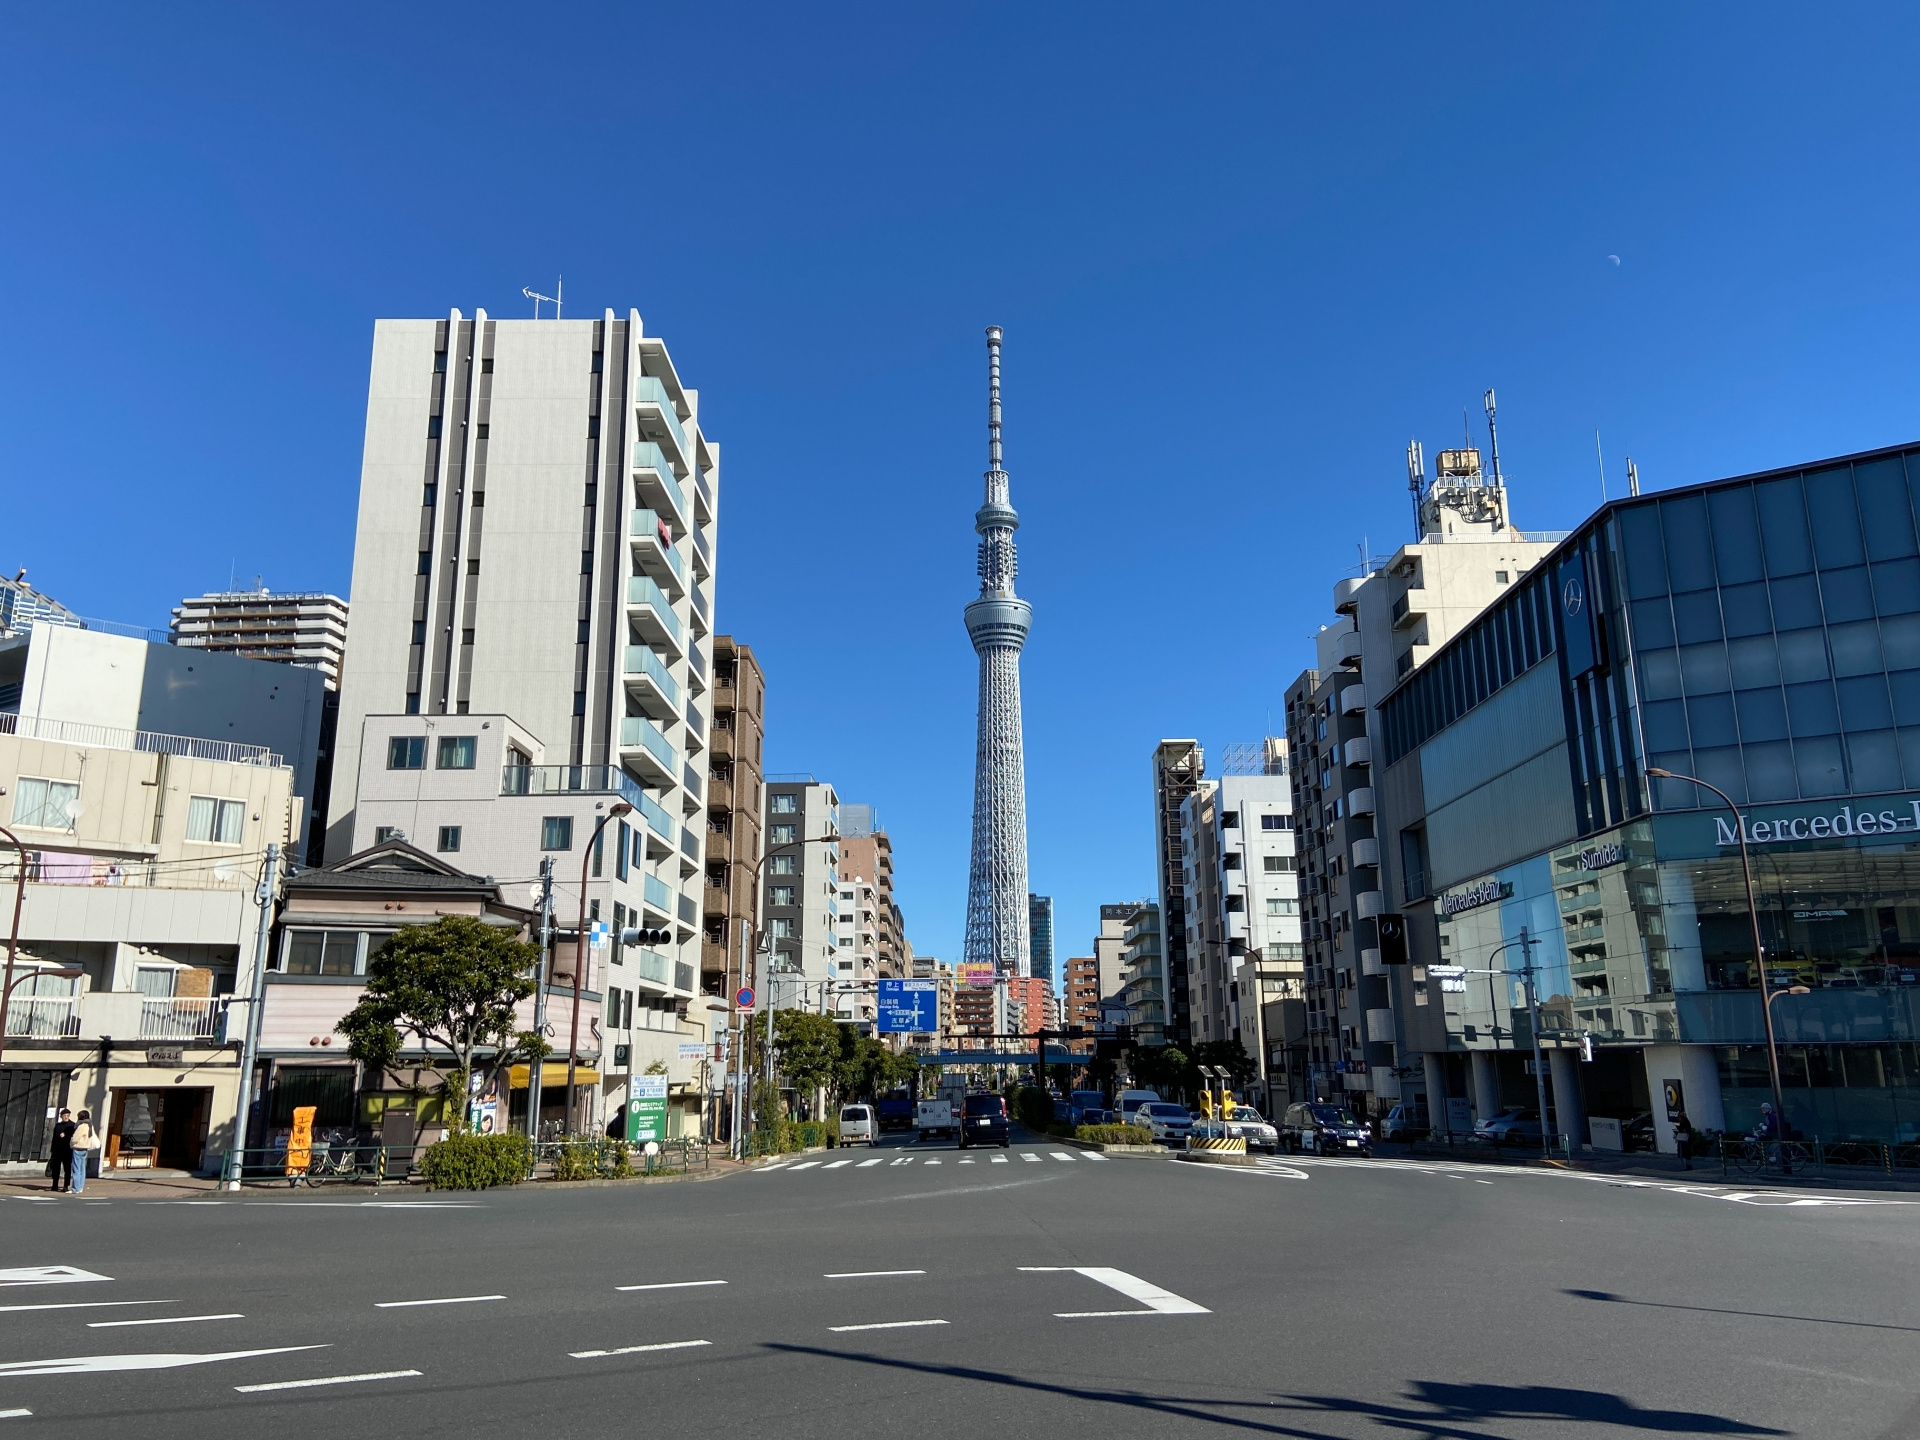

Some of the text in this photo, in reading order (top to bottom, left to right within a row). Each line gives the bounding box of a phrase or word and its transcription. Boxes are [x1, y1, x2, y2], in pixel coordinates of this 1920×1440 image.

[1581, 843, 1617, 870] Sumida
[1439, 880, 1501, 914] Mercedes-Benz
[296, 1117, 311, 1146] 工事中
